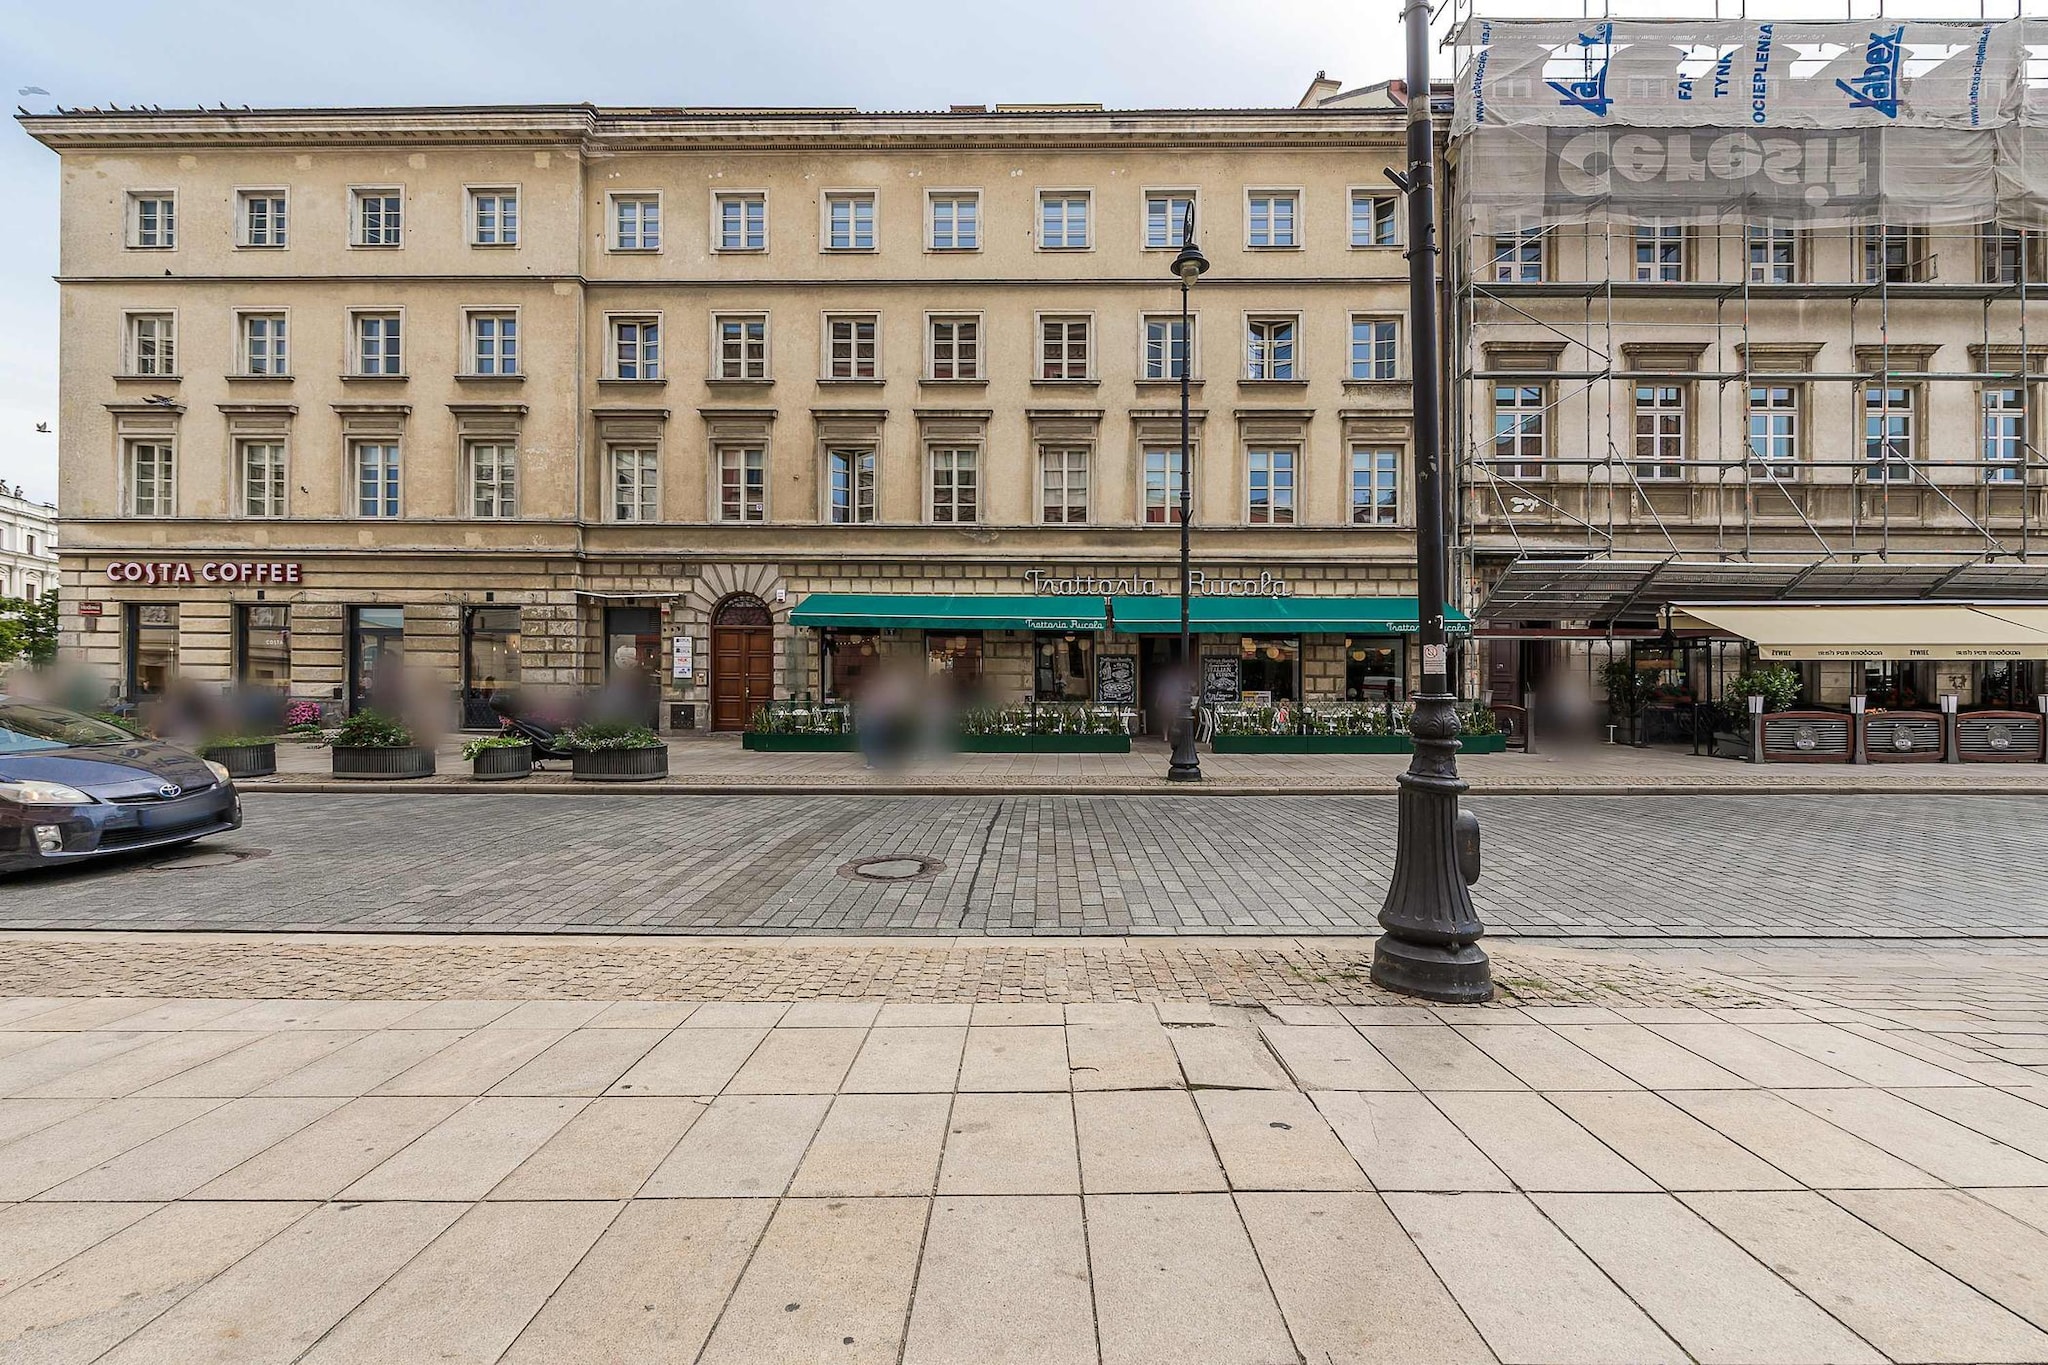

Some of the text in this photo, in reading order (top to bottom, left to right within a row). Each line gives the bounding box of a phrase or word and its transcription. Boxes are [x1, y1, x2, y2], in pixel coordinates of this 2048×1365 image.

[1752, 23, 1774, 124] OCIEPLENIA
[106, 561, 302, 585] COSTA COFFEE
[1023, 568, 1293, 596] Trattoria Rucola
[1025, 619, 1104, 629] Trattoria Rucola
